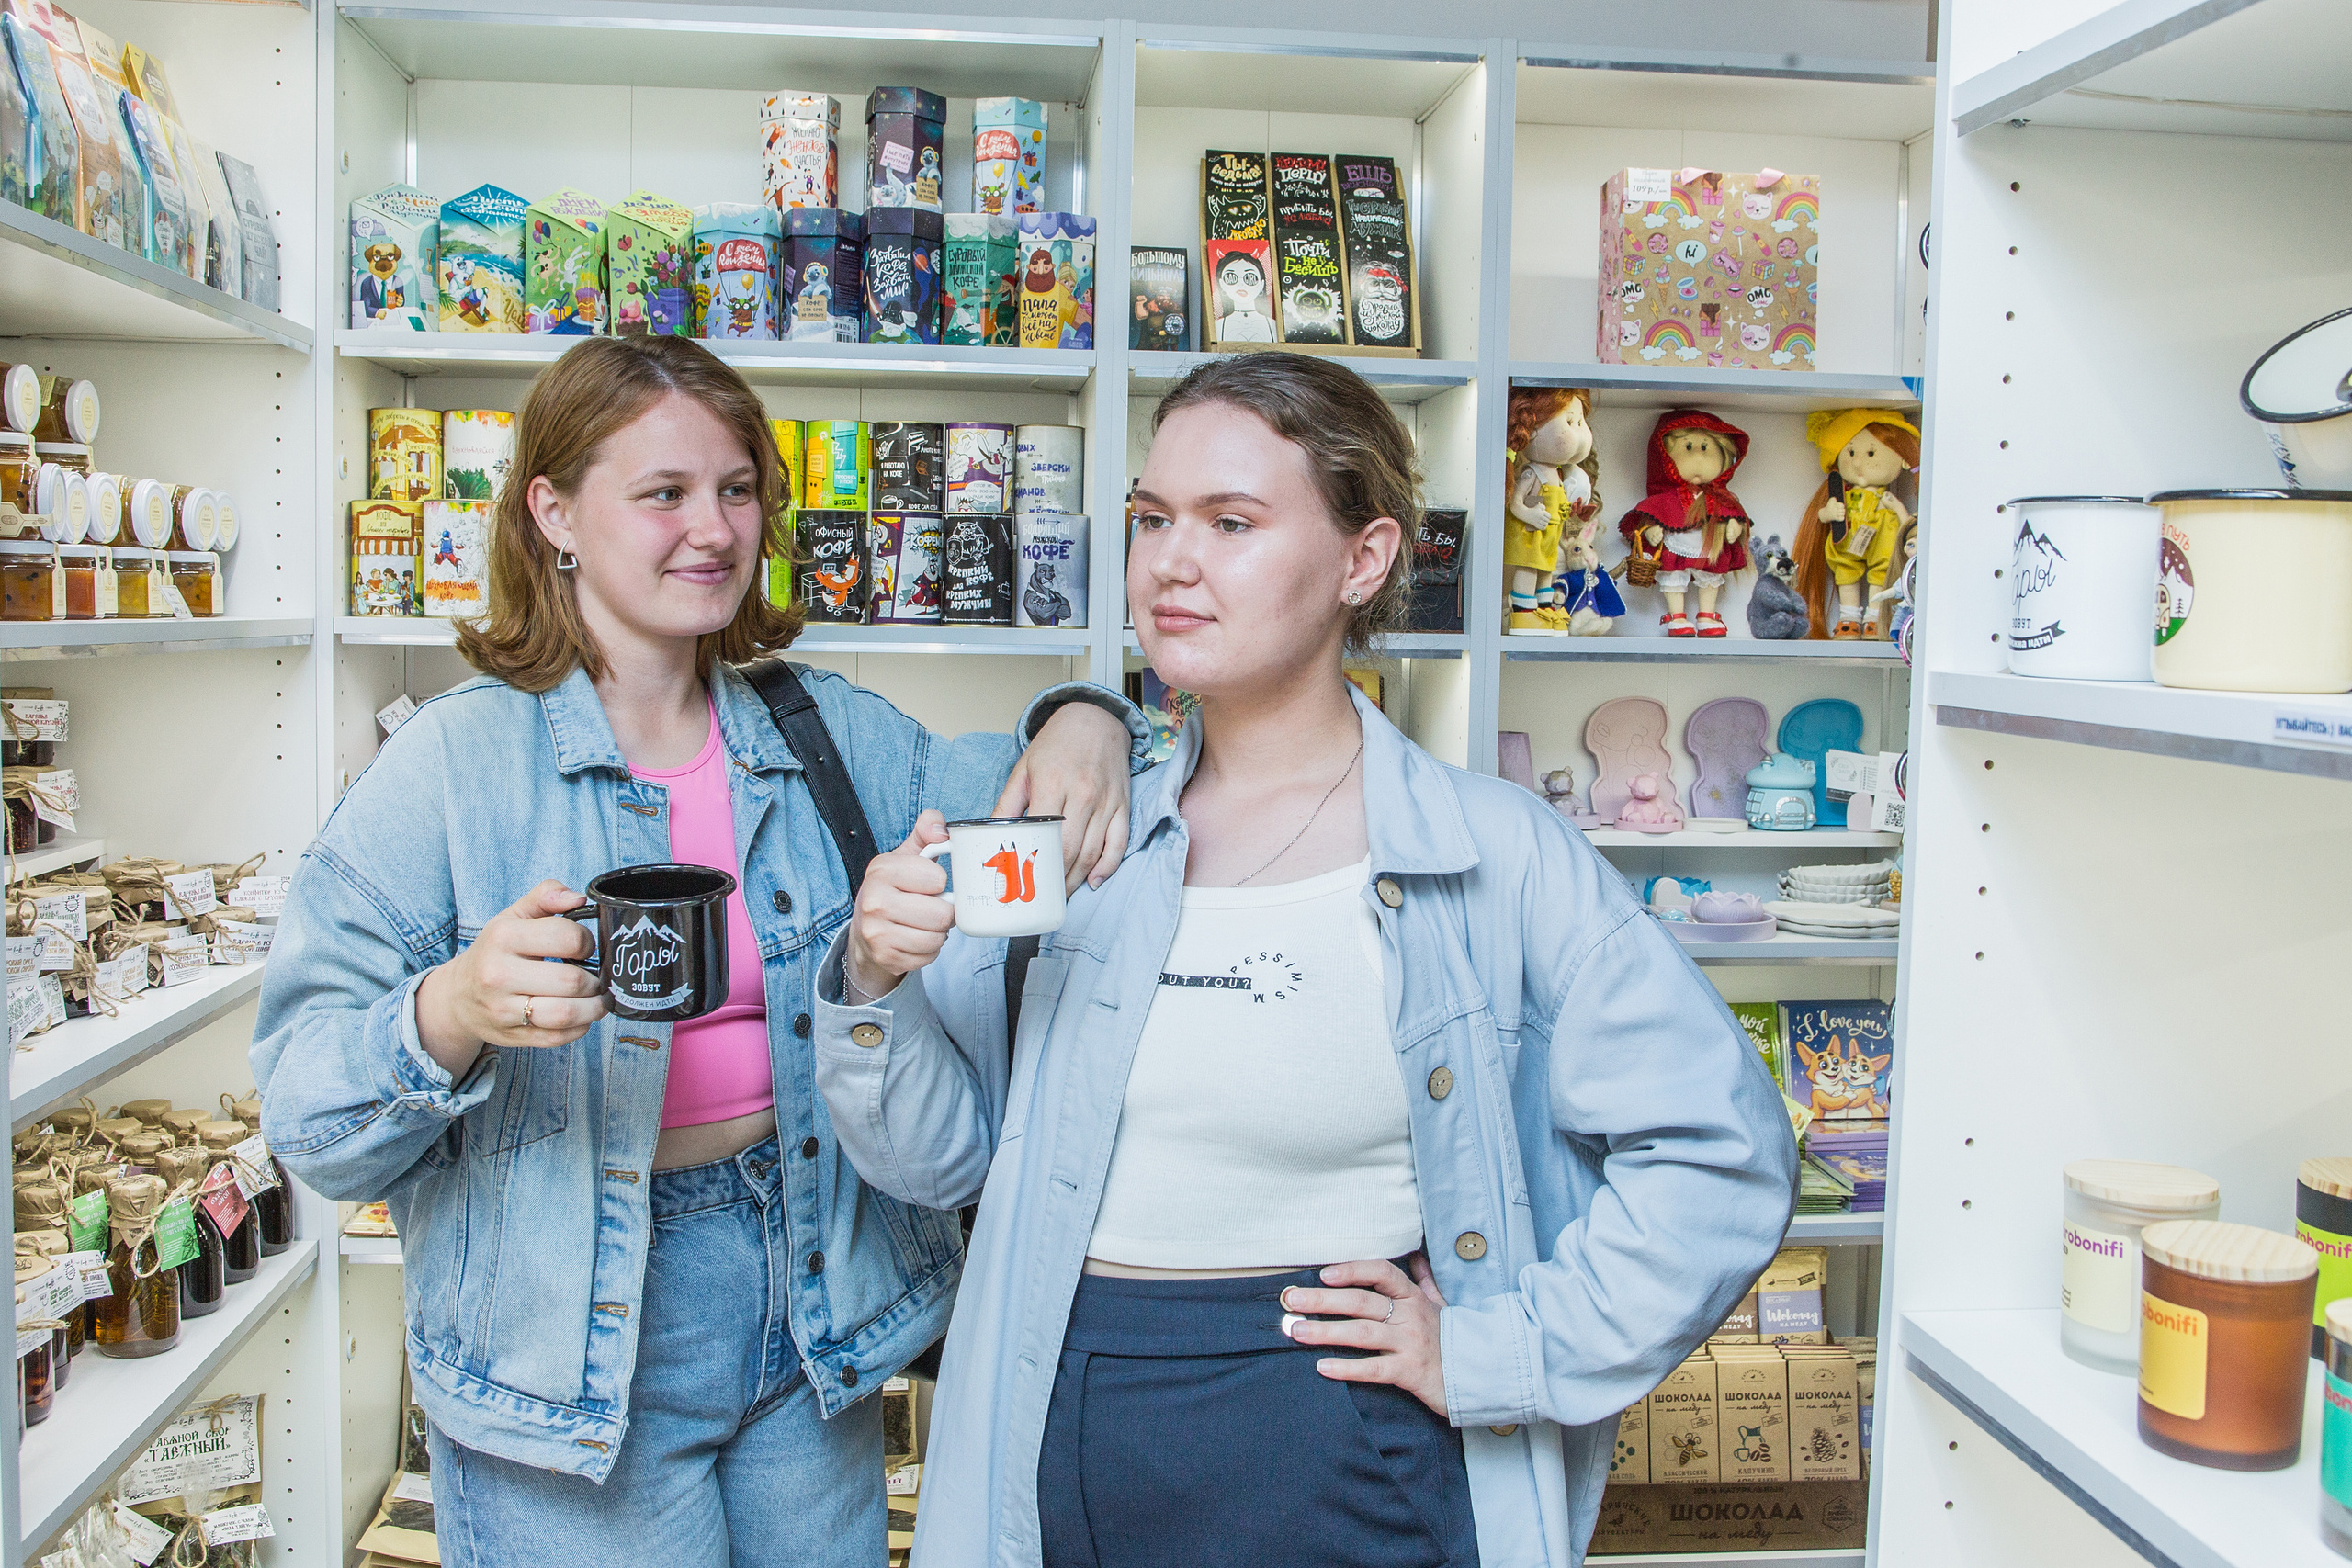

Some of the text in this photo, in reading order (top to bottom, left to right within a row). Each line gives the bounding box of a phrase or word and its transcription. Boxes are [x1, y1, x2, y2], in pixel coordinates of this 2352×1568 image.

[1344, 165, 1392, 184] ЕШЬ
[1279, 202, 1317, 215] ПРИБИТЬ
[1350, 221, 1403, 240] МУЖИК
[726, 242, 734, 257] С
[1685, 245, 1698, 258] hi
[1131, 252, 1185, 269] БОЛЬШОМУ
[953, 276, 979, 290] КОФЕ
[1224, 273, 1259, 285] BAD GIRL
[1621, 283, 1642, 298] OMG
[1747, 288, 1771, 303] OMG
[885, 461, 906, 469] РАБОТАЮ
[1031, 463, 1070, 473] ЗВЕРСКИ
[1023, 521, 1070, 536] БОДРЯЩИЙ
[1032, 536, 1058, 544] МУЖСКОЙ
[2166, 526, 2191, 551] ПУТЬ
[813, 538, 854, 558] КОФЕ
[1023, 544, 1070, 560] КОФЕ
[947, 564, 989, 578] КРЕПКИЙ
[966, 572, 995, 586] КОФЕ
[952, 582, 964, 591] ДЛЯ
[945, 589, 982, 599] КРЕПКИХ
[950, 598, 992, 611] МУЖЧИН
[612, 941, 680, 984] Горы
[631, 983, 661, 992] ЗОВУТ
[1202, 976, 1250, 989] YOU?
[625, 998, 654, 1009] ДОЛЖЕН
[656, 997, 678, 1007] ИДТИ
[1797, 1010, 1888, 1042] I love you
[2064, 1226, 2123, 1258] robonifi
[1726, 1314, 1754, 1329] олад
[1767, 1308, 1819, 1325] Шоколад
[1655, 1393, 1711, 1404] ШОКОЛАД
[1725, 1391, 1781, 1402] ШОКОЛАД
[1795, 1390, 1851, 1401] ШОКОЛАД
[1679, 1403, 1701, 1416] меду
[1750, 1401, 1771, 1414] меду
[1820, 1400, 1841, 1413] меду
[1737, 1467, 1775, 1475] КАПУЧИНО
[1670, 1502, 1803, 1522] ШОКОЛАД
[1698, 1522, 1774, 1546] на меду
